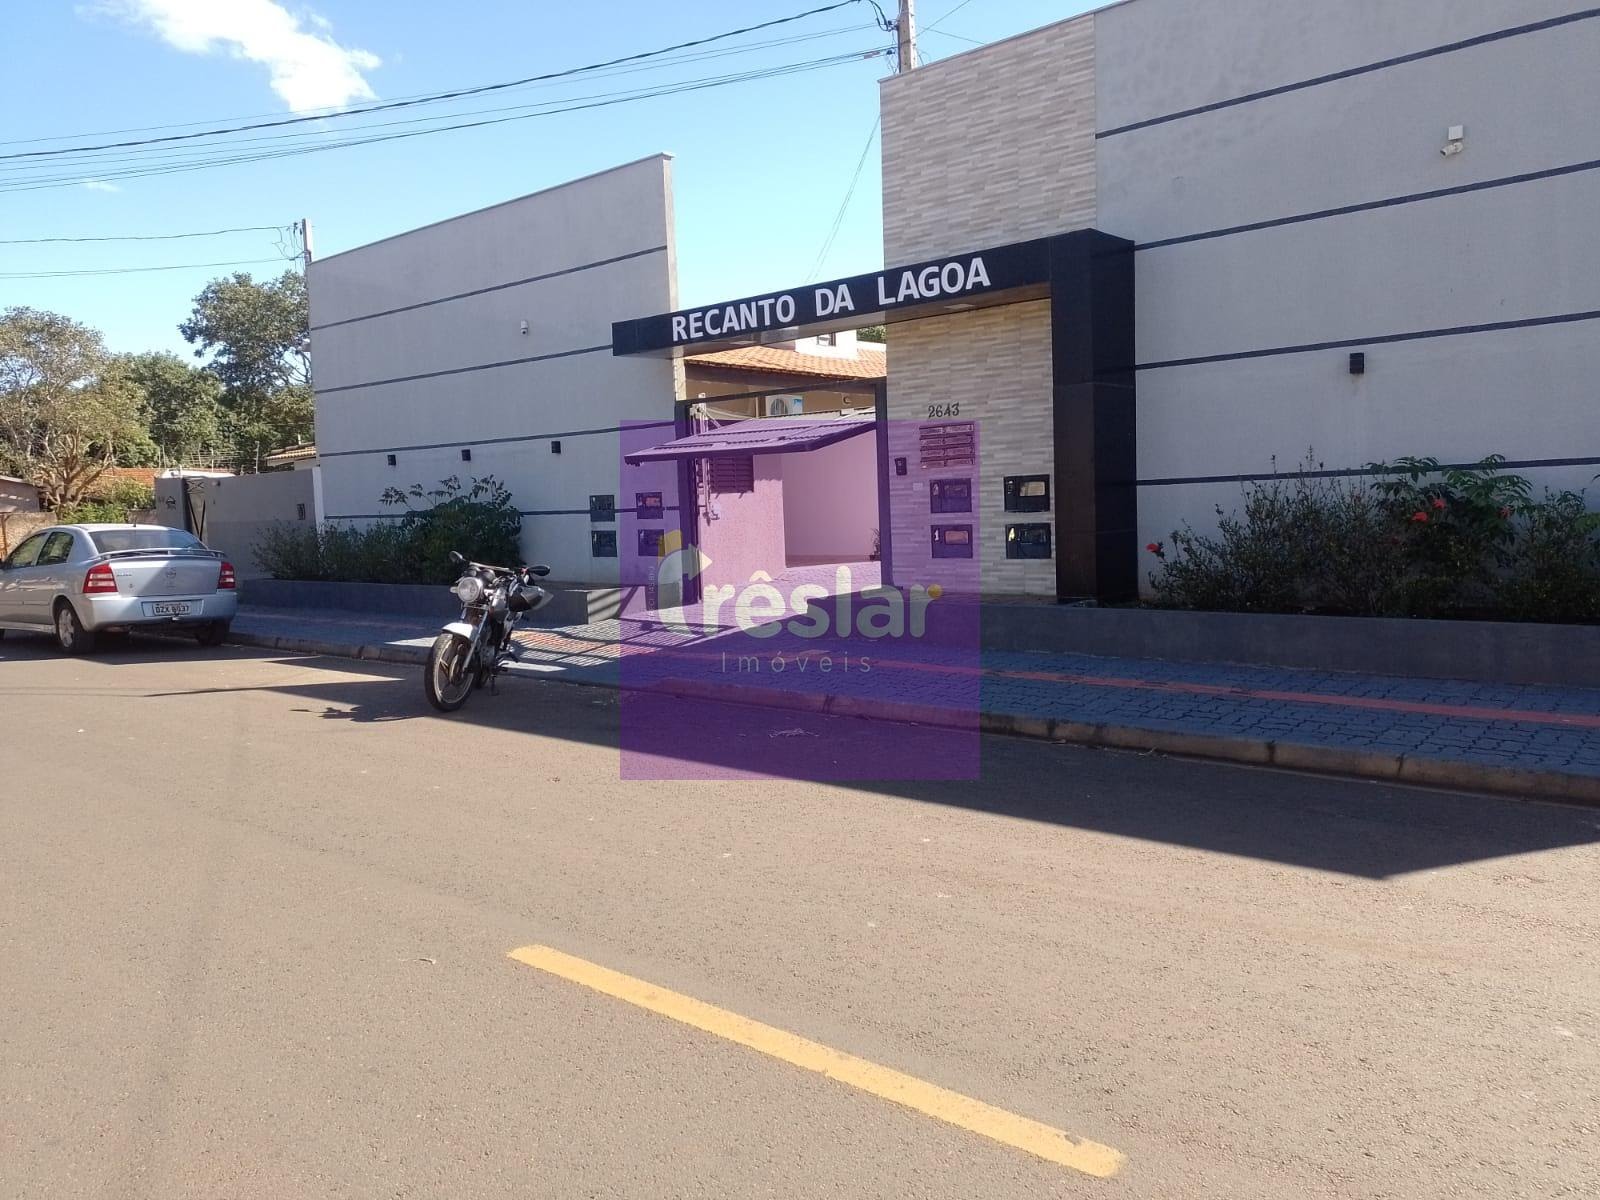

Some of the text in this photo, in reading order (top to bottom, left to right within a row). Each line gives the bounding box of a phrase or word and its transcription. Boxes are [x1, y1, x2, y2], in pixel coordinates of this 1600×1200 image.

[671, 257, 992, 342] RECANTO DA LAGOA
[929, 402, 960, 418] 2643
